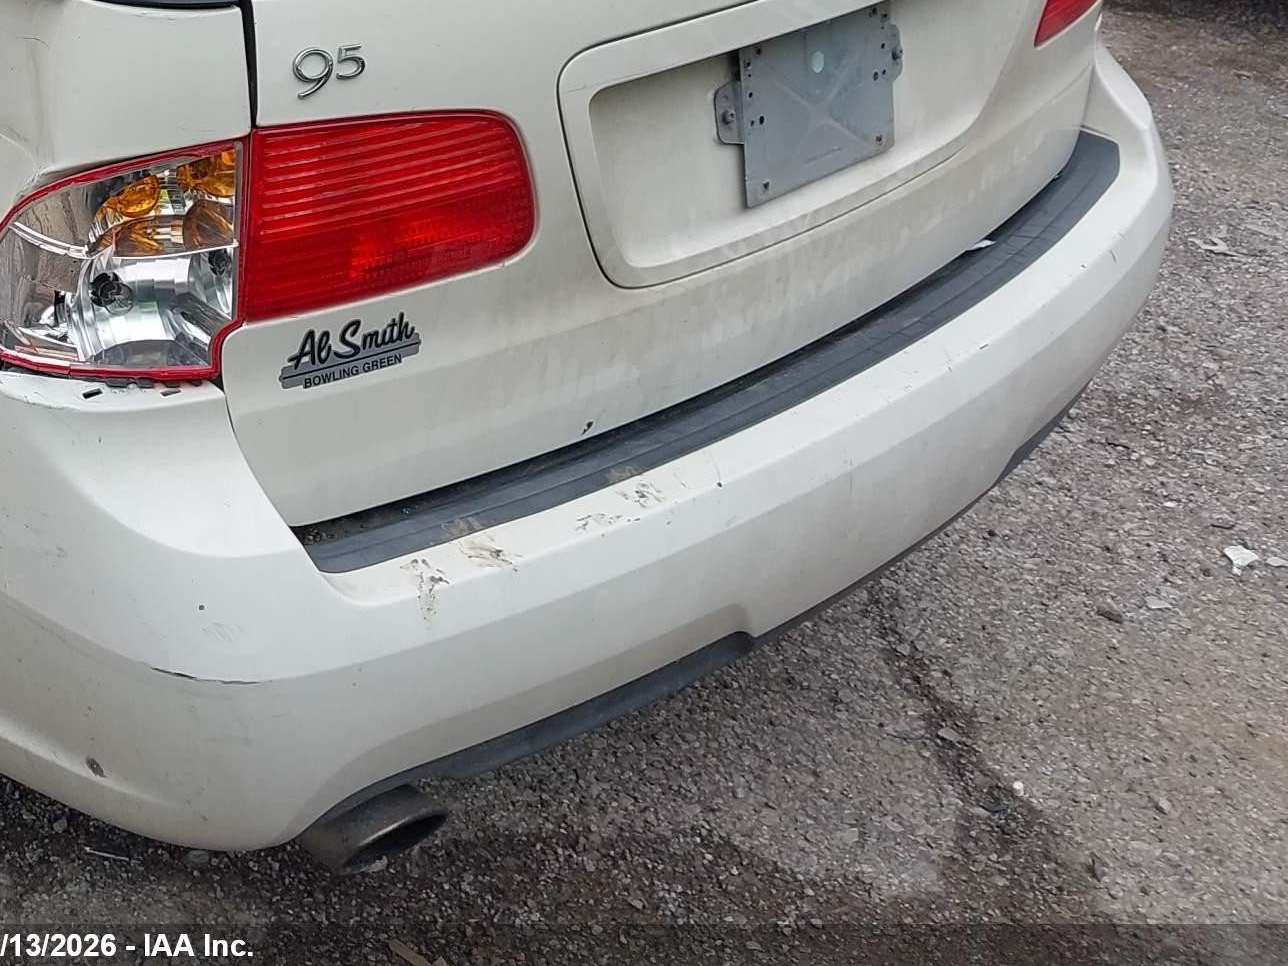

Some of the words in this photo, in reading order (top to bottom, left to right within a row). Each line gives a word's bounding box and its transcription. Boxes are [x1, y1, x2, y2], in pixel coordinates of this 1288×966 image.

[292, 42, 366, 100] 95
[287, 328, 332, 370] Al
[333, 311, 415, 360] Smith
[303, 365, 360, 389] BOWLING
[362, 353, 403, 372] GREEN
